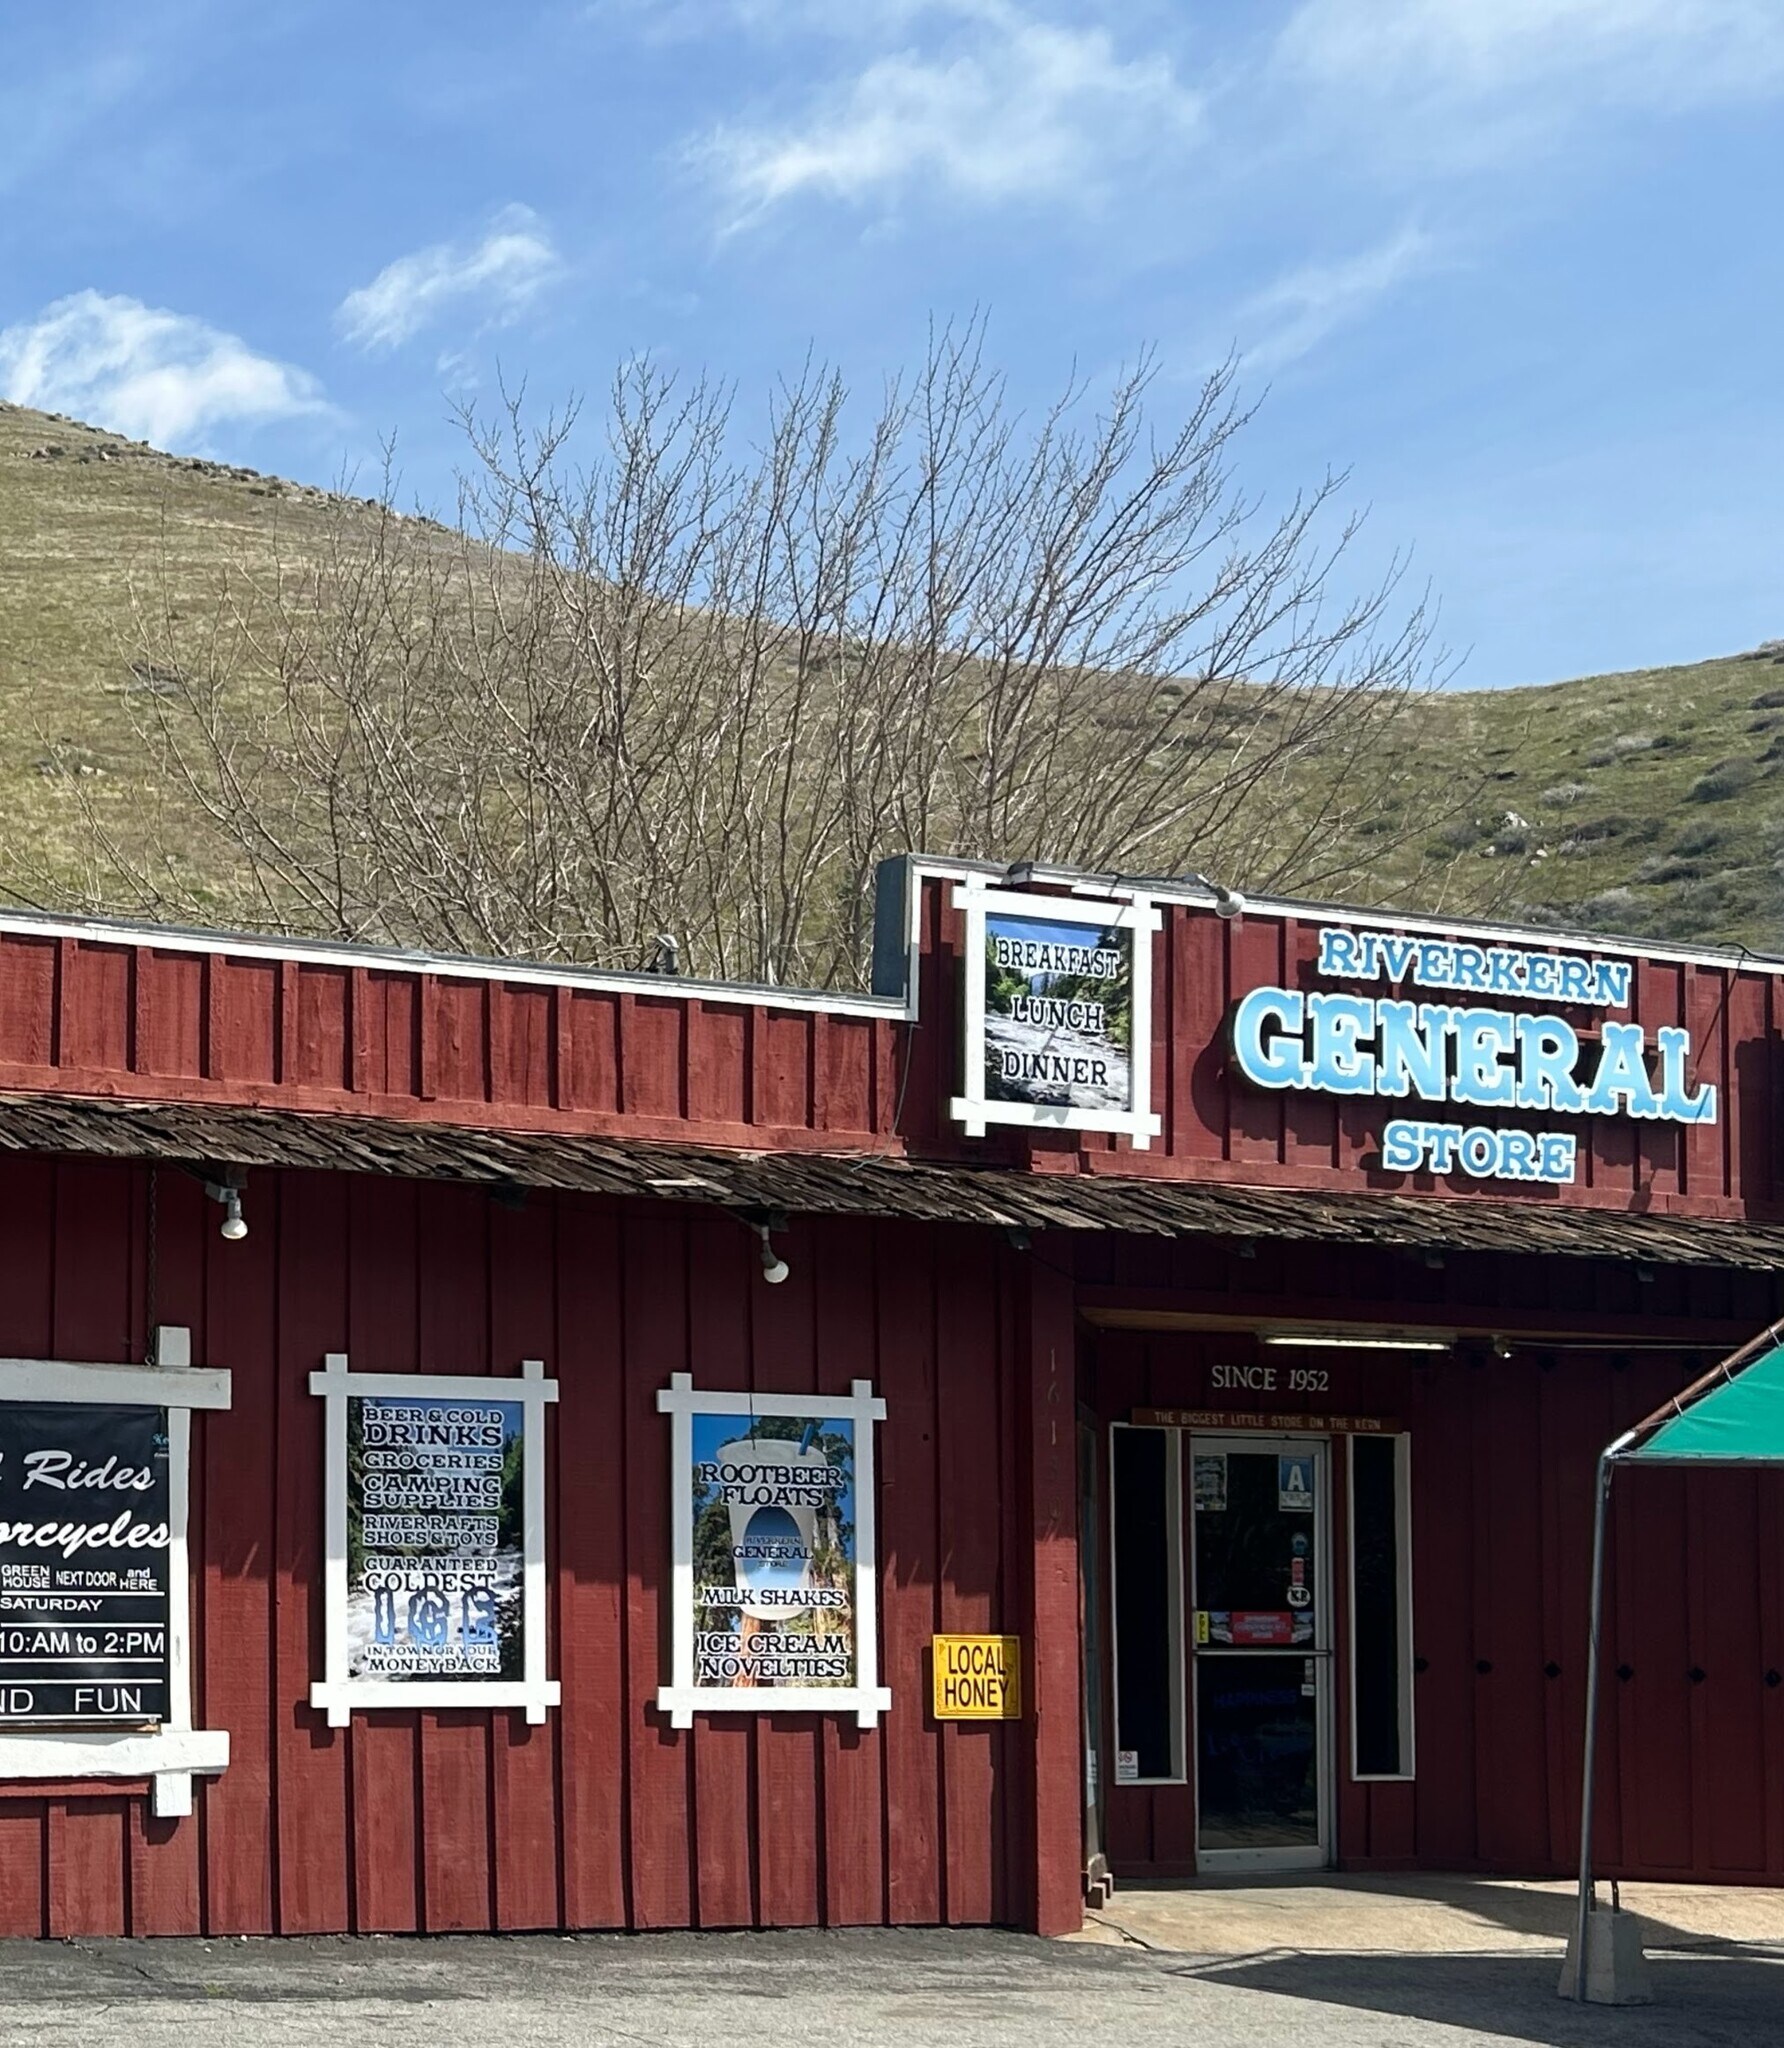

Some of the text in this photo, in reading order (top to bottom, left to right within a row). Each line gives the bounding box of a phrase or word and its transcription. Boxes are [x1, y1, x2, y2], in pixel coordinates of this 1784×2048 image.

[997, 939, 1120, 977] BREAKFAST
[1319, 928, 1631, 1008] RIVERKERN
[1012, 996, 1103, 1031] LUNCH
[1234, 986, 1717, 1124] GENERAL
[1003, 1051, 1109, 1087] DINNER
[1383, 1119, 1577, 1183] STORE
[1211, 1365, 1329, 1392] SINCE 1952
[364, 1407, 503, 1424] BEER & COLD
[1154, 1411, 1382, 1431] THE BIGGEST LITTLE STORE ON THE KERN
[364, 1423, 502, 1446] DRINKS
[22, 1449, 156, 1490] Rides
[364, 1452, 502, 1470] GROCERIES
[364, 1475, 501, 1495] CAMPING
[700, 1463, 843, 1487] ROOTBEER
[1286, 1464, 1306, 1491] A
[364, 1493, 500, 1508] SUPPLIES
[722, 1486, 824, 1507] FLOATS
[364, 1515, 498, 1531] RIVER RAFTS
[364, 1531, 496, 1546] SHOES & TOYS
[732, 1545, 814, 1560] GENERAL
[1, 1564, 50, 1577] GREEN
[126, 1567, 151, 1578] and
[365, 1557, 498, 1571] GUARANTEED
[2, 1577, 50, 1589] HOUSE
[56, 1570, 117, 1587] NEXT DOOR
[119, 1578, 157, 1590] HERE
[364, 1573, 496, 1592] COLDEST
[0, 1597, 103, 1611] SATURDAY
[702, 1588, 844, 1607] MILK SHAKES
[374, 1586, 499, 1650] ICE
[75, 1632, 98, 1654] to
[104, 1632, 165, 1654] 2:PM
[367, 1646, 383, 1656] IN
[385, 1645, 433, 1656] TOWN
[436, 1646, 455, 1656] OR
[698, 1633, 847, 1654] ICE CREAM
[367, 1658, 499, 1672] MONEY BACK
[700, 1657, 846, 1678] NOVELTIES
[948, 1645, 1007, 1675] LOCAL
[74, 1687, 142, 1713] FUN
[944, 1677, 1009, 1708] HONEY
